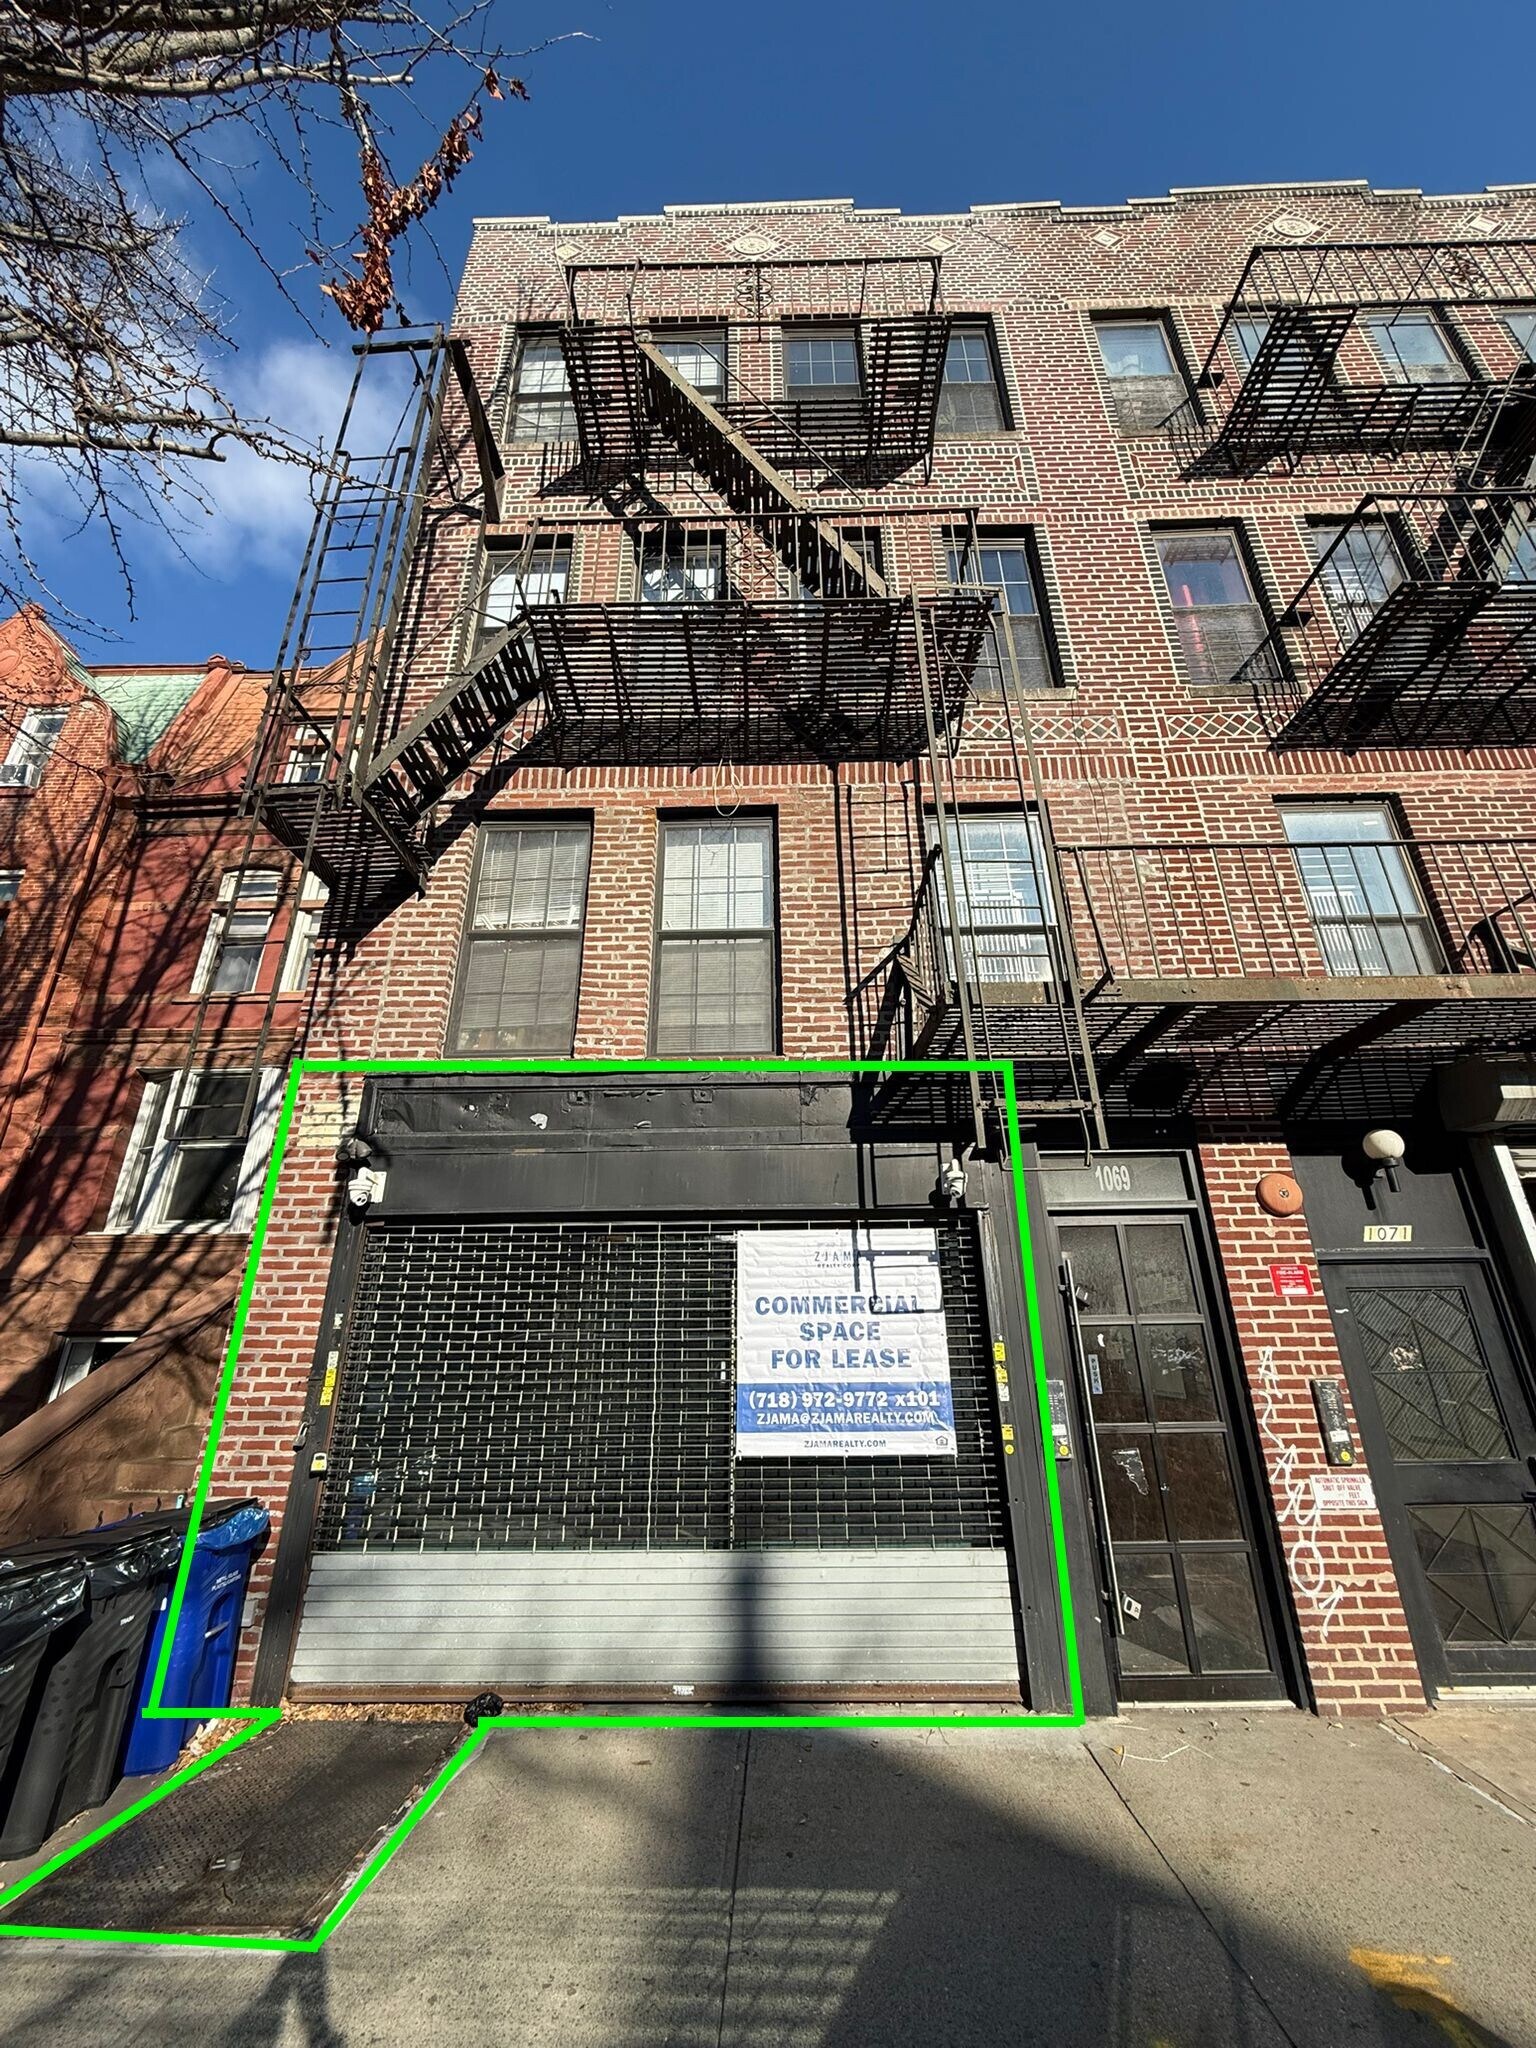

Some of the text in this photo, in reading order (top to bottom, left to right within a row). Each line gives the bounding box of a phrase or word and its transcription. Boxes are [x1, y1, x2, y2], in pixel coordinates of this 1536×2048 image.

[1095, 1165, 1130, 1191] 1069
[1369, 1226, 1407, 1240] 1071
[755, 1295, 924, 1316] COMMERCIAL
[799, 1321, 881, 1341] SPACE
[771, 1347, 913, 1369] FOR LEASE
[749, 1389, 940, 1409] (718) 972-9772 x101
[756, 1410, 937, 1425] ZJAMA@ZJAMAREALTY.COM
[803, 1439, 887, 1449] ZJAMAREALTY.COM
